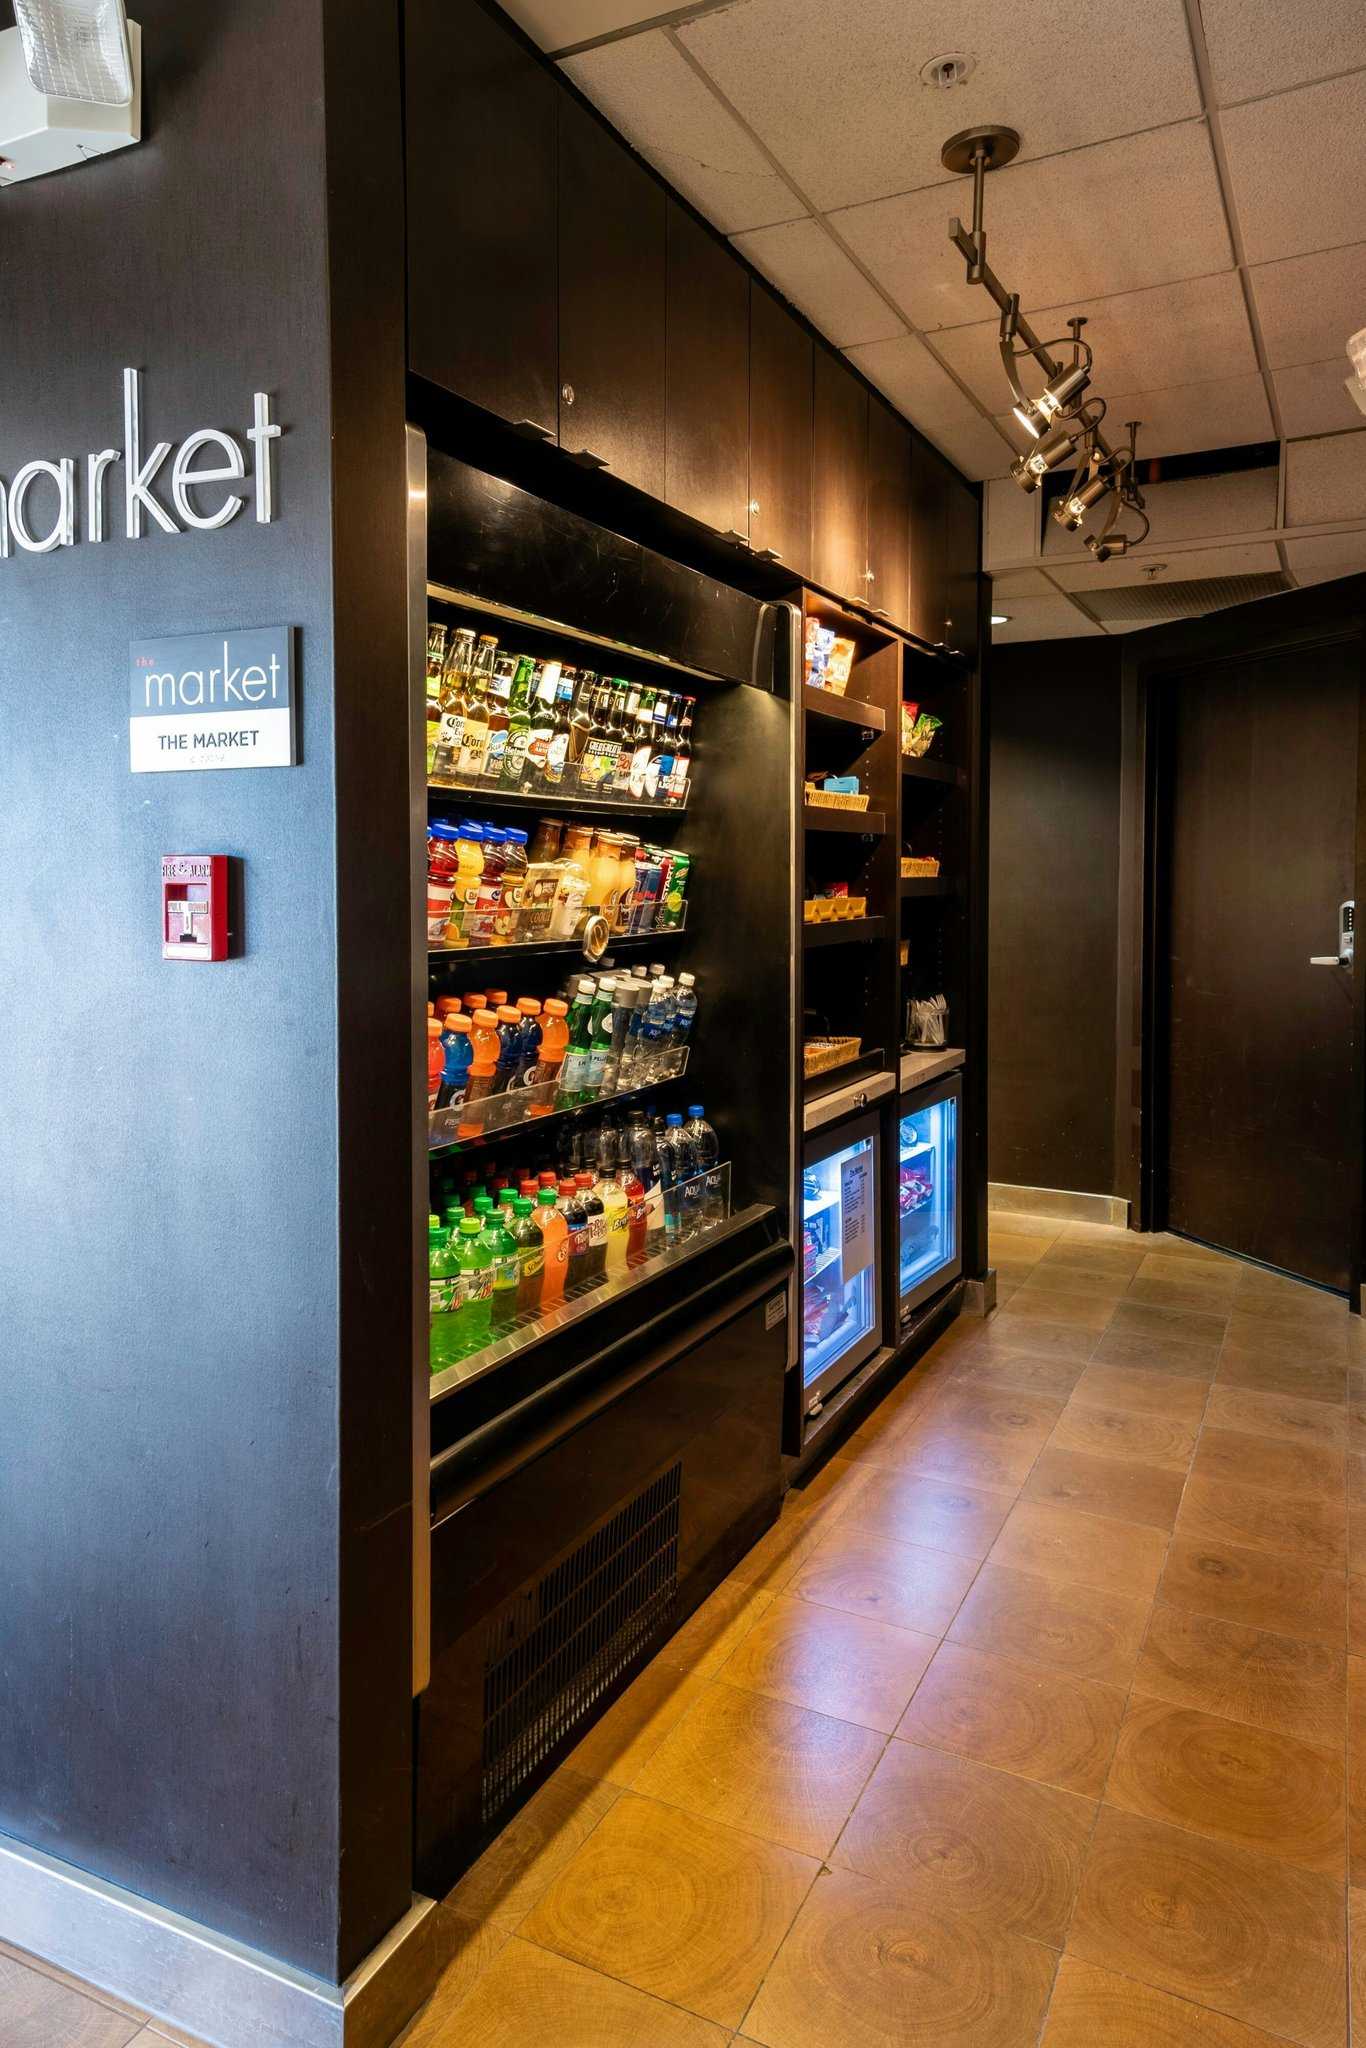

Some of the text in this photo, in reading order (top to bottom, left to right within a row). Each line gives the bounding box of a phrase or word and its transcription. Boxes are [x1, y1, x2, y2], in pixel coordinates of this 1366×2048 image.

[145, 640, 281, 708] market
[158, 730, 259, 750] THE MARKET
